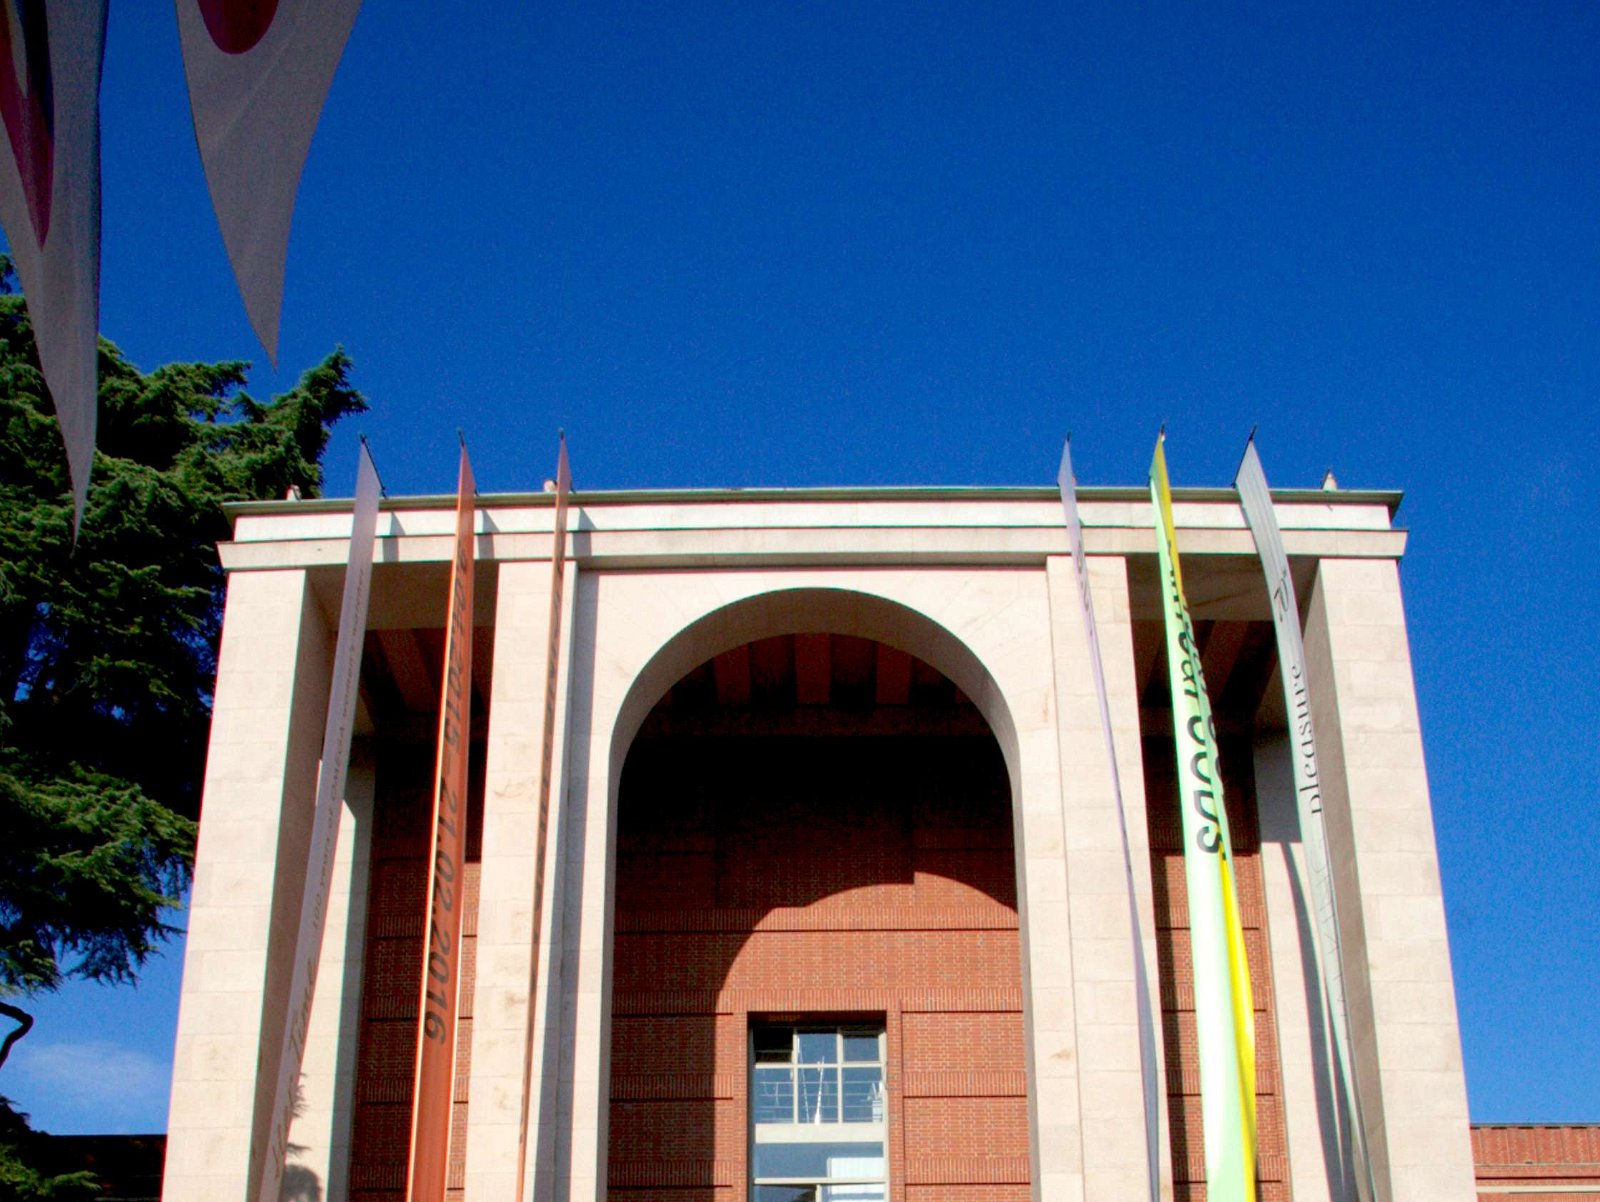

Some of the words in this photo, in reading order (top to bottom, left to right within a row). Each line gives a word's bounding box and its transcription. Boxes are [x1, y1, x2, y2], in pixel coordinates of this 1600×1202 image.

[330, 726, 346, 802] OMEGA
[1290, 664, 1323, 815] pleasure
[424, 777, 460, 1045] 21.02.2016
